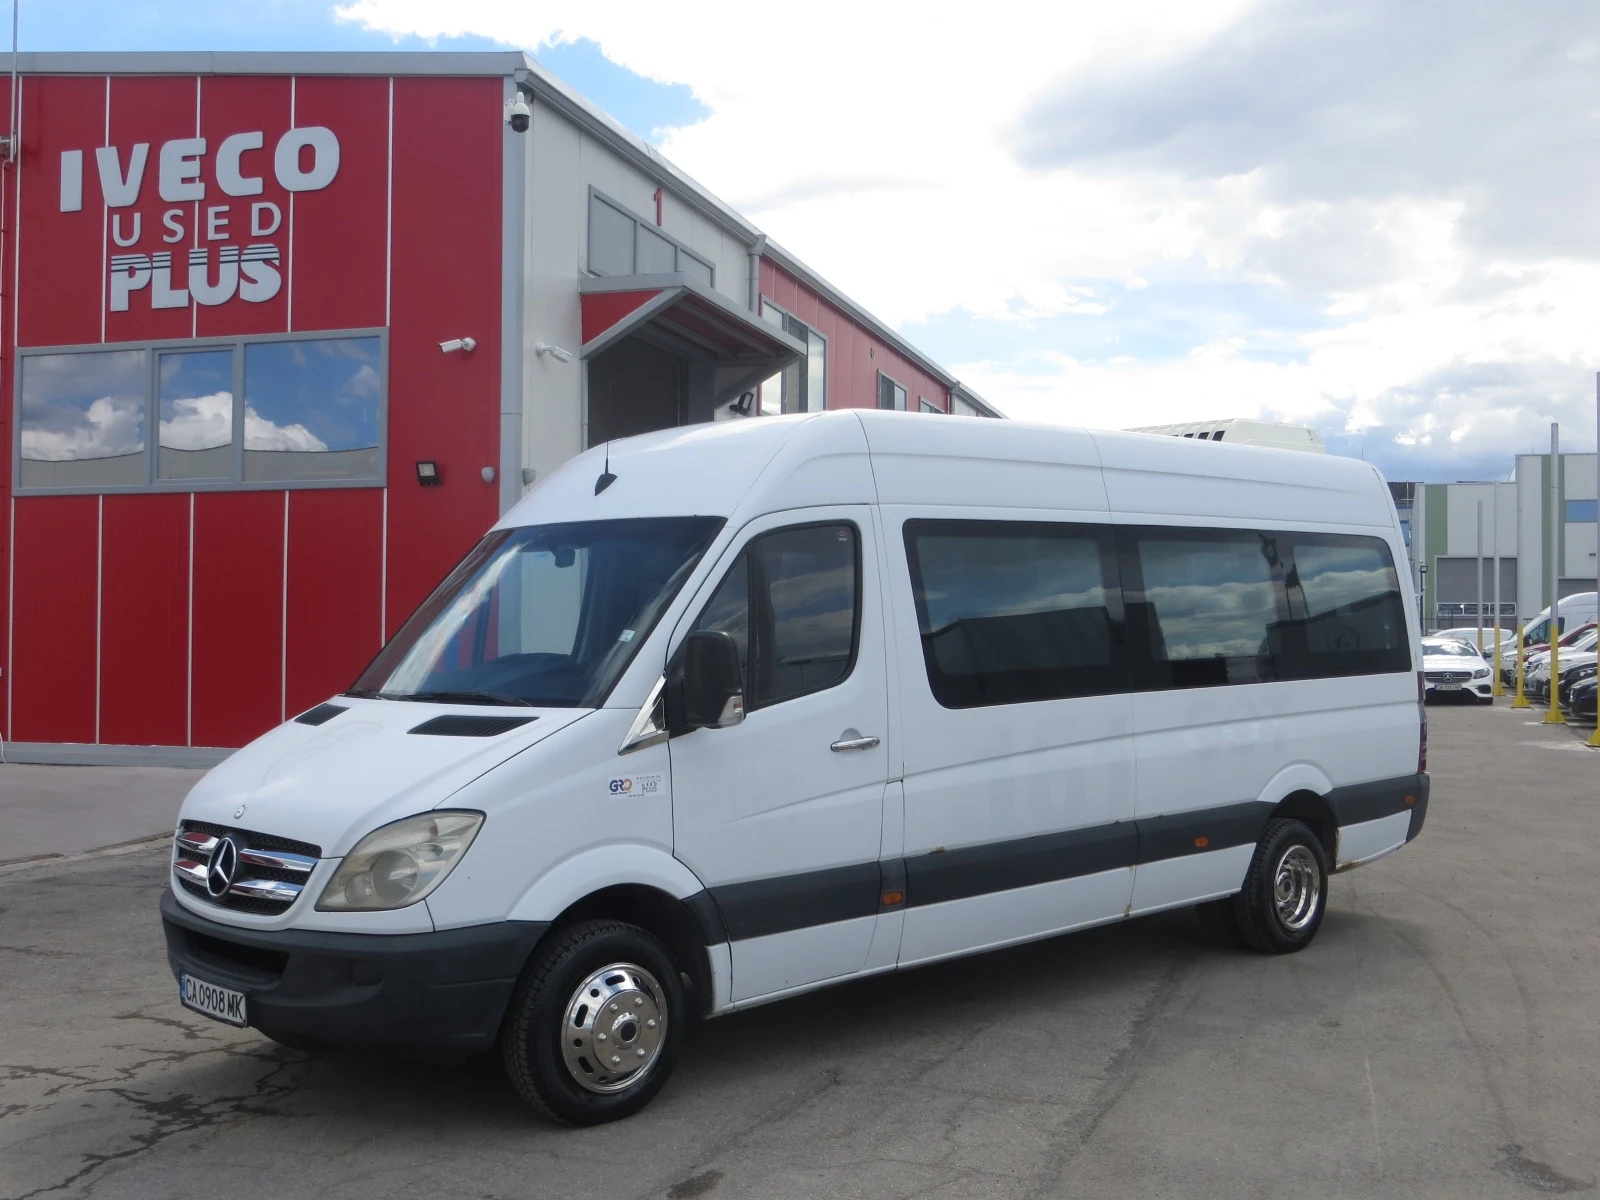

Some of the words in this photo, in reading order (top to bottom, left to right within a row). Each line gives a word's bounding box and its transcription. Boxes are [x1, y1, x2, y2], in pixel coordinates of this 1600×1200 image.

[60, 126, 339, 213] IVECO
[112, 202, 282, 247] USED
[653, 187, 662, 227] 1
[111, 243, 282, 312] PLUS
